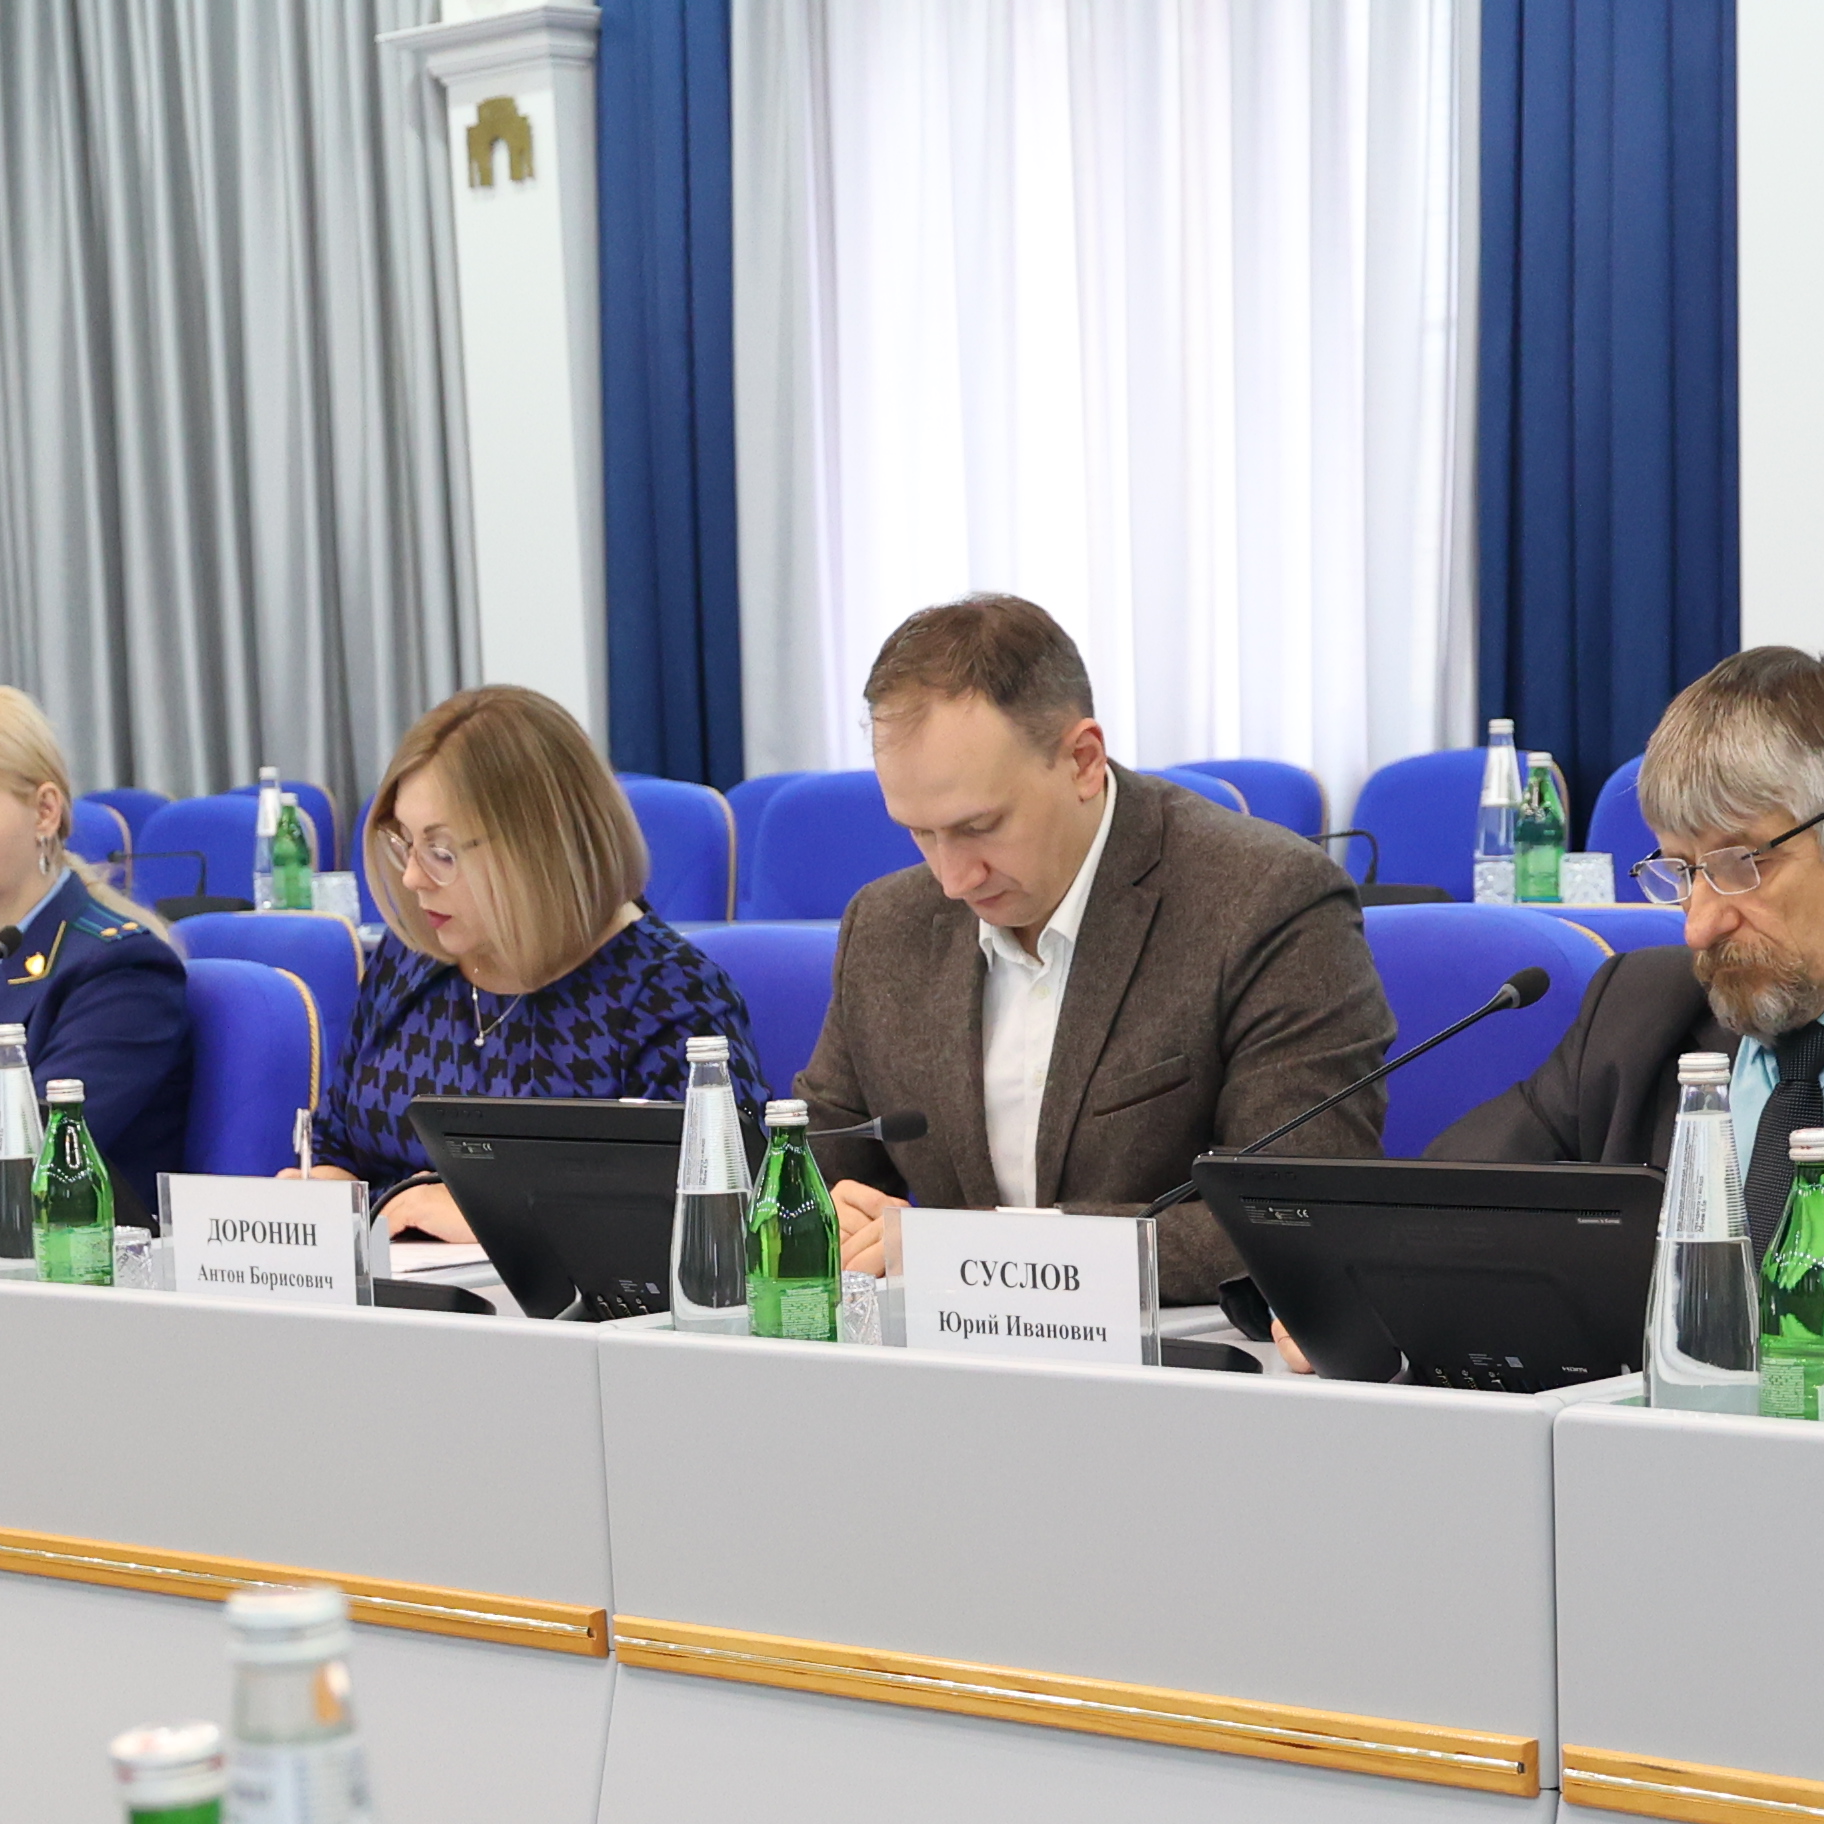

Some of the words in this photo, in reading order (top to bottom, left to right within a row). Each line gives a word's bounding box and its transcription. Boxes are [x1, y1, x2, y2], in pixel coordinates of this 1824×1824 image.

[207, 1218, 318, 1247] ДОРОНИН
[197, 1264, 245, 1284] Антон
[250, 1266, 334, 1291] Борисович
[960, 1259, 1081, 1291] СУСЛОВ
[938, 1311, 999, 1339] Юрий
[1005, 1315, 1108, 1343] Иванович
